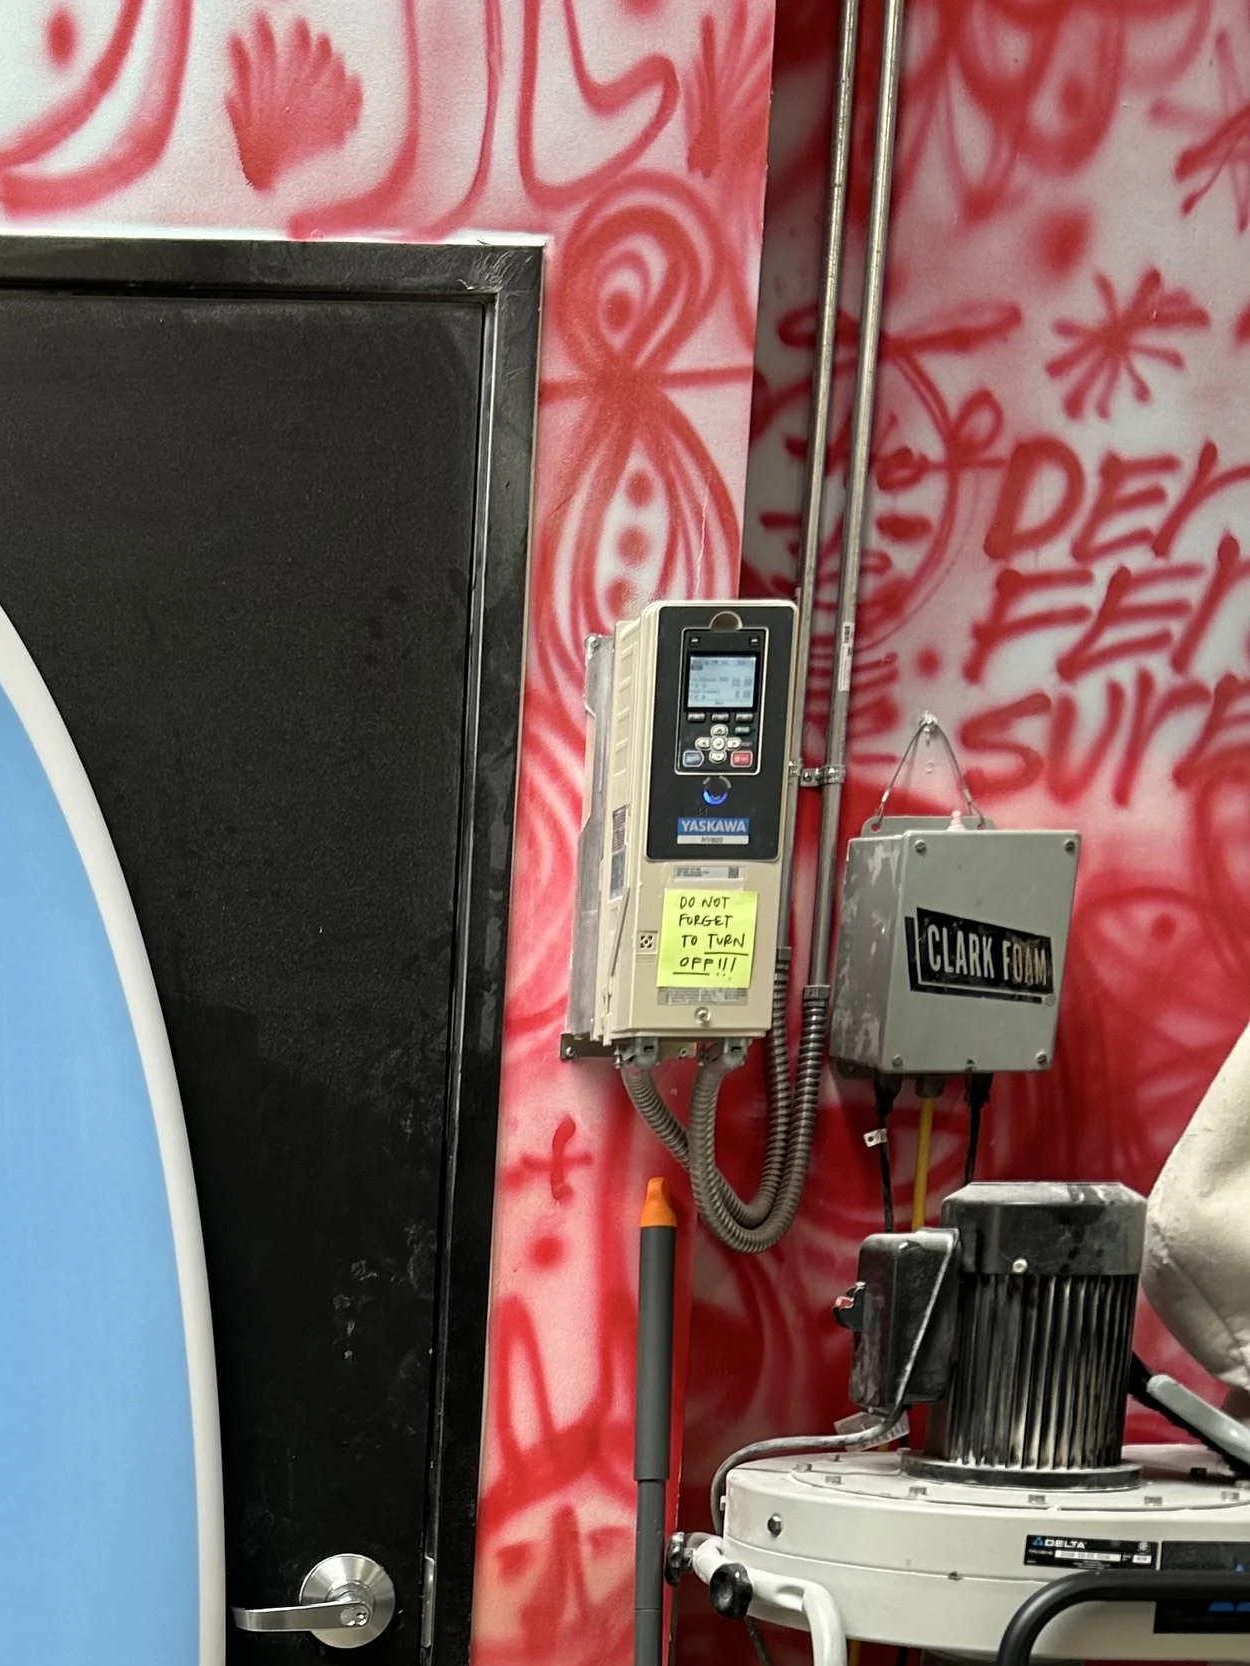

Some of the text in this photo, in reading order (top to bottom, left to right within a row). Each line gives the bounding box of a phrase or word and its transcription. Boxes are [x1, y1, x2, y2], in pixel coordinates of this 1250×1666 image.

[681, 819, 747, 833] YASKAWA
[680, 896, 731, 909] DO NOT
[679, 914, 733, 927] FORGET
[681, 933, 746, 948] TO TURN
[927, 923, 1047, 986] CLARK FOAM
[1044, 1538, 1085, 1549] DELTA
